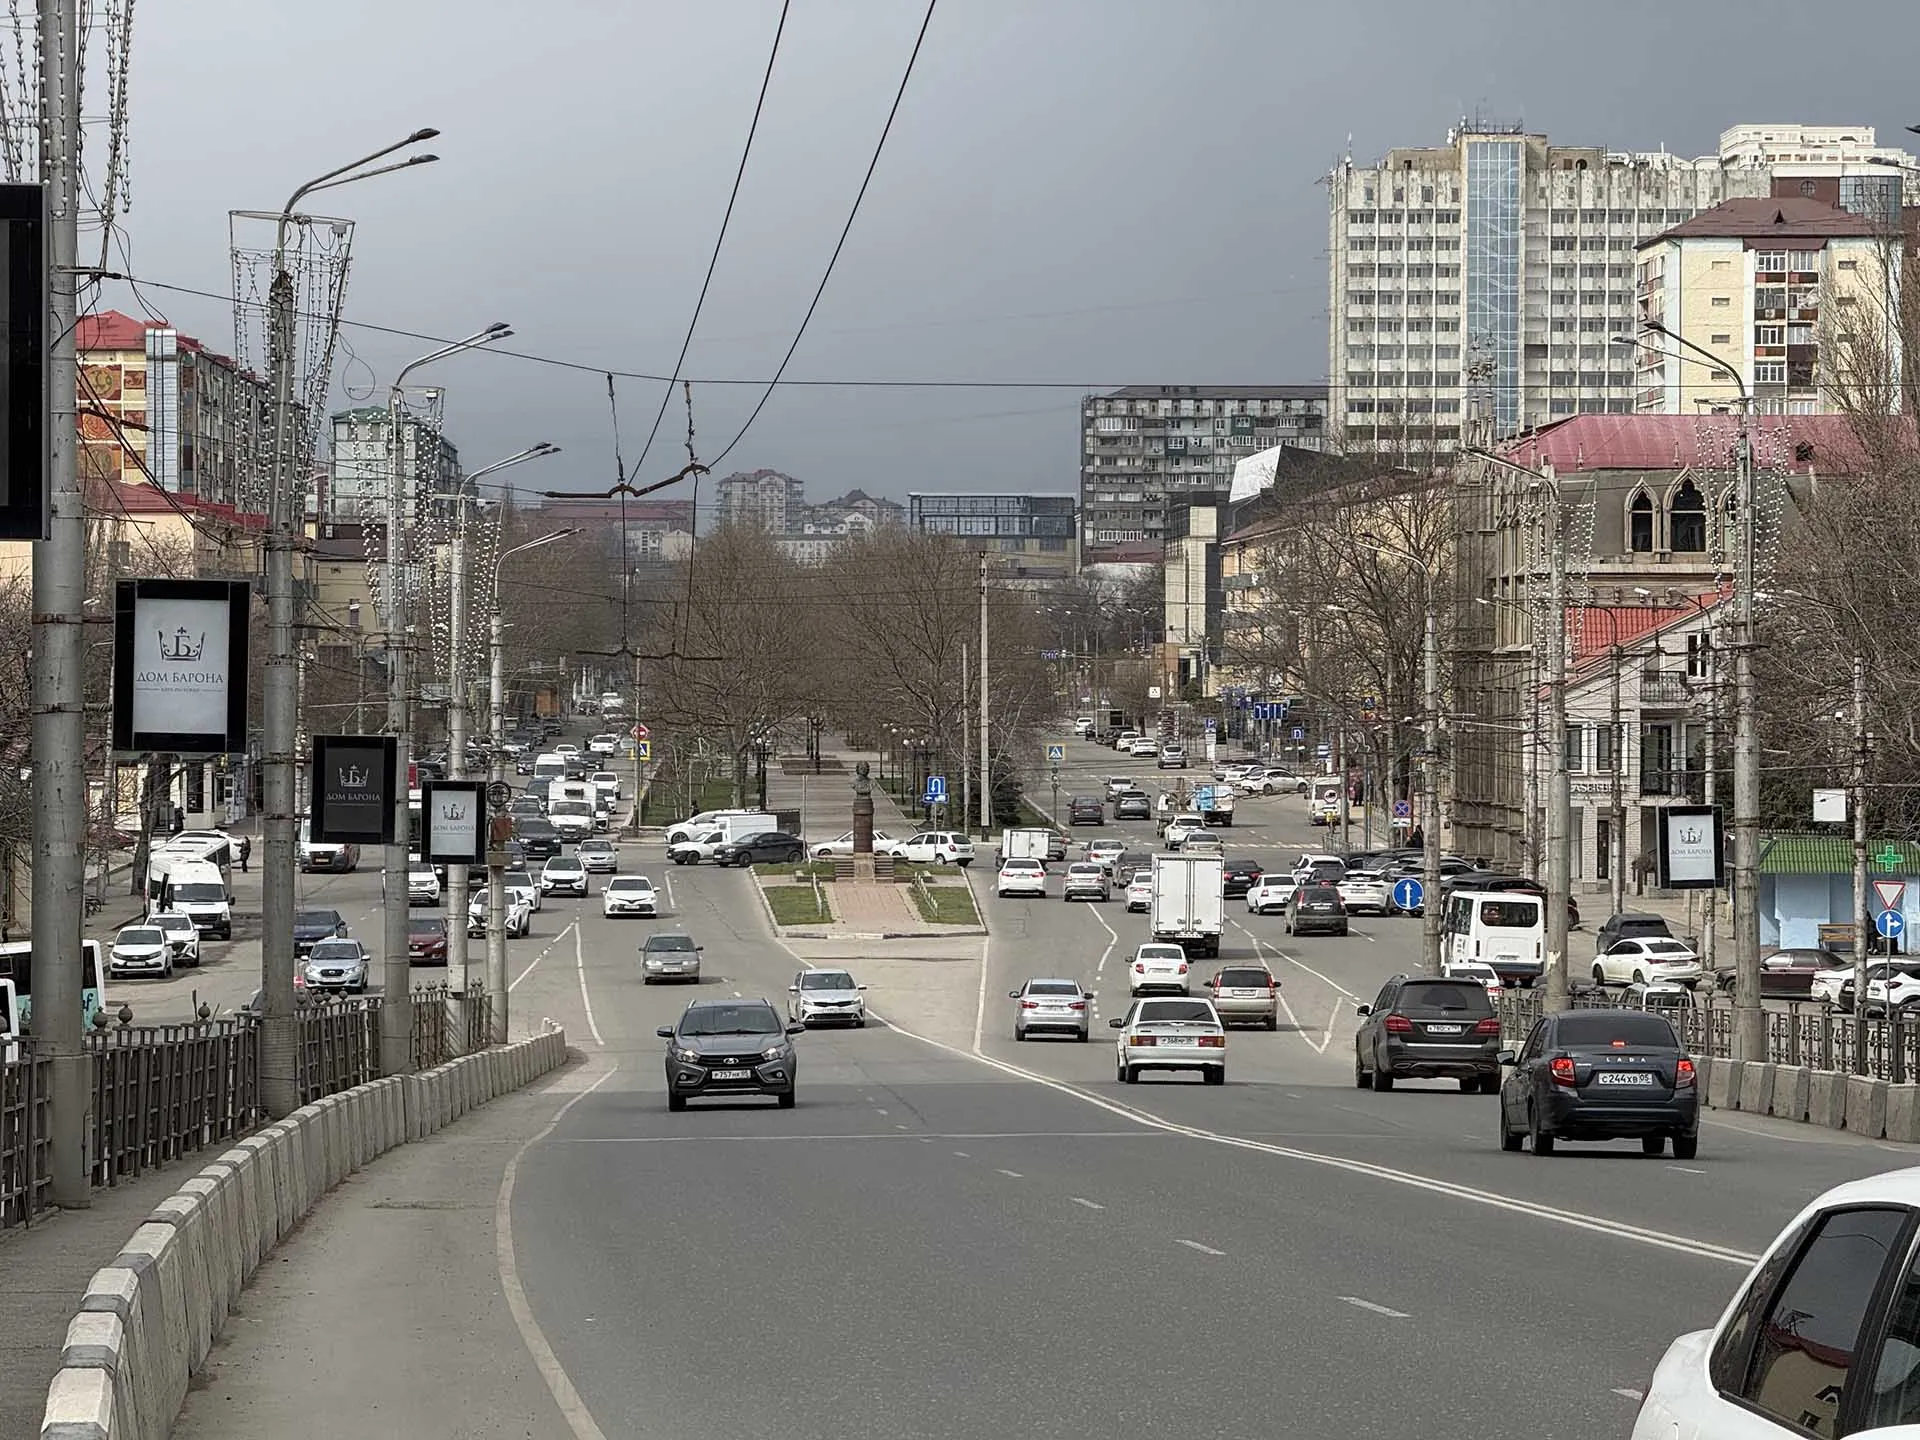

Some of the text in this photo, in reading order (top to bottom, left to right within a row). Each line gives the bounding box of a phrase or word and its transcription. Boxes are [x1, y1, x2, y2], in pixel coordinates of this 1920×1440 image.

[136, 671, 224, 684] ДОМ БАРОНА
[326, 792, 380, 801] ДОМ БАРОНА
[1606, 1056, 1647, 1064] LADA
